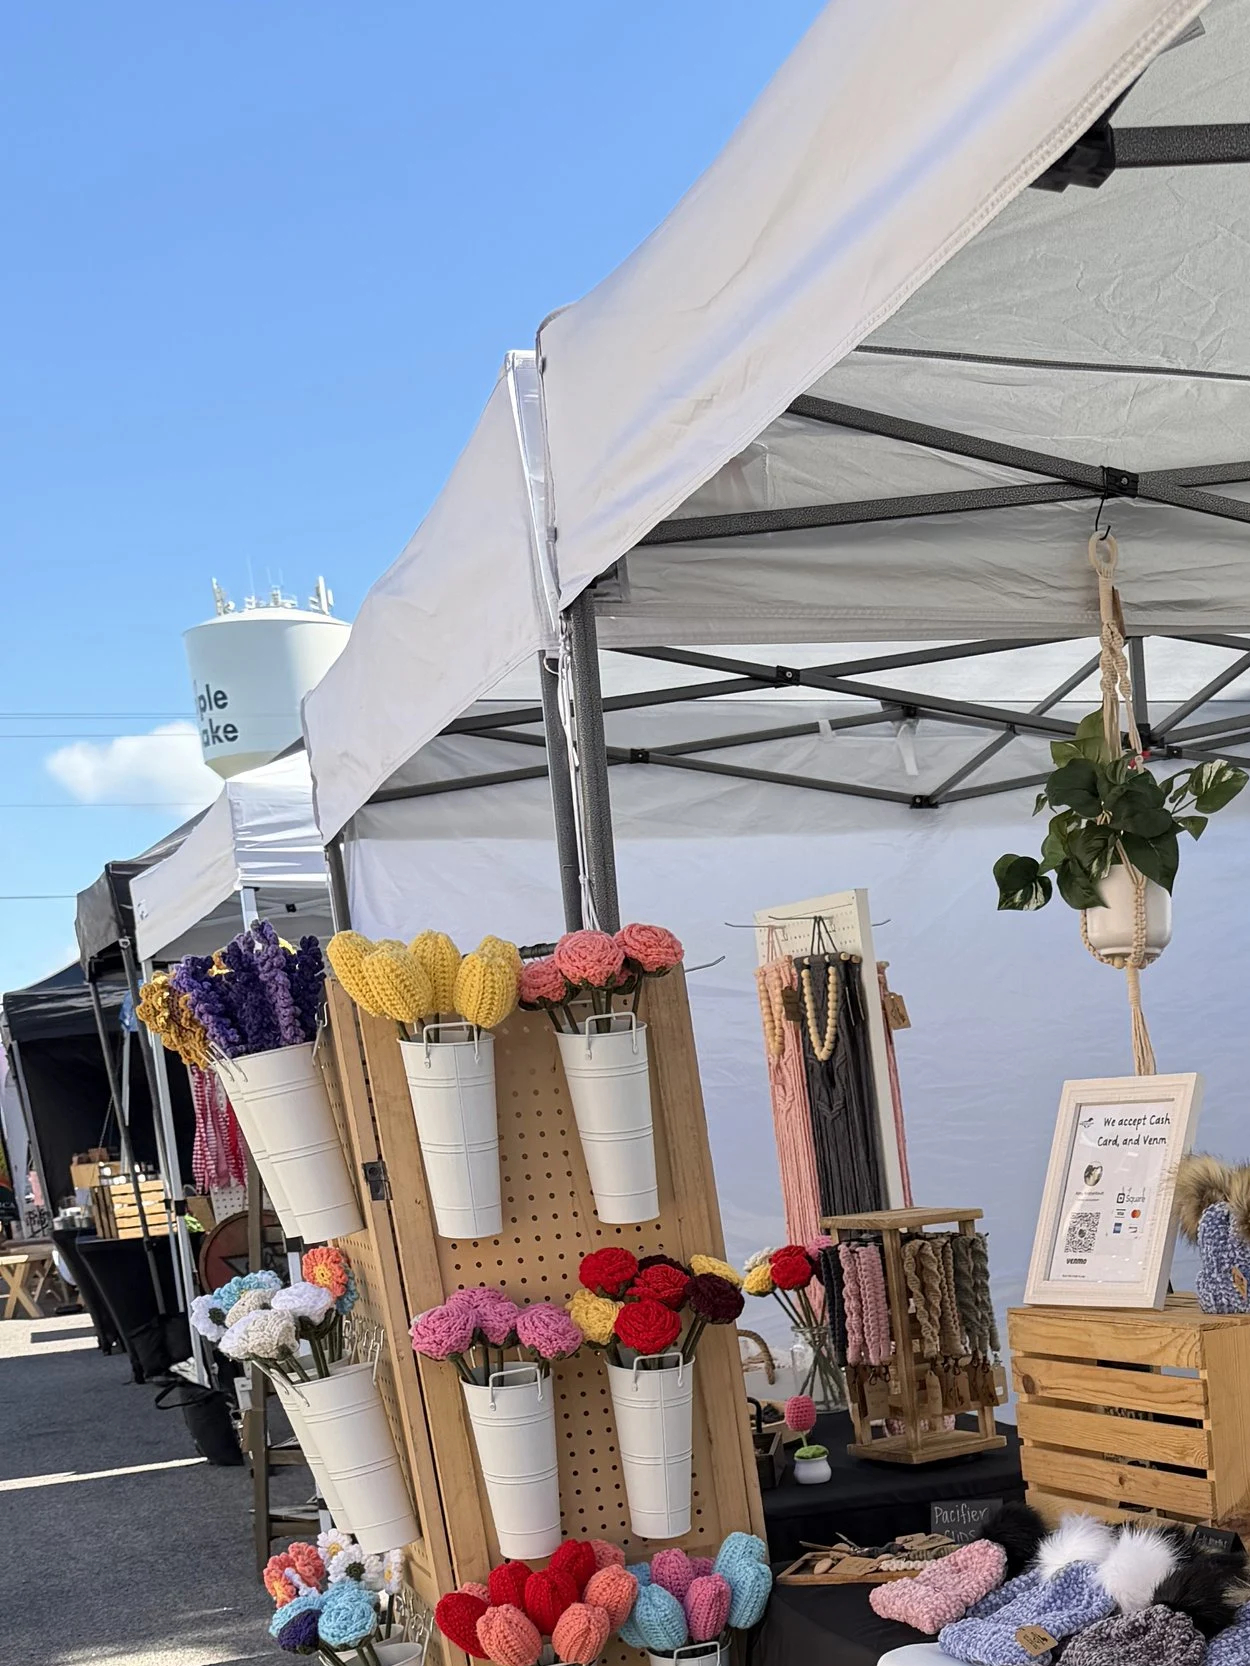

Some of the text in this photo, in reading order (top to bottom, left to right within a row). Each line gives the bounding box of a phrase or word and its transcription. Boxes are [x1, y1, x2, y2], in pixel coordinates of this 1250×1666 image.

[193, 680, 229, 722] ple
[201, 718, 240, 748] ake
[1103, 1113, 1171, 1131] We accept Cash
[1097, 1134, 1167, 1147] Card, and Venm
[1125, 1194, 1146, 1204] Square
[934, 1503, 989, 1524] Pacifier
